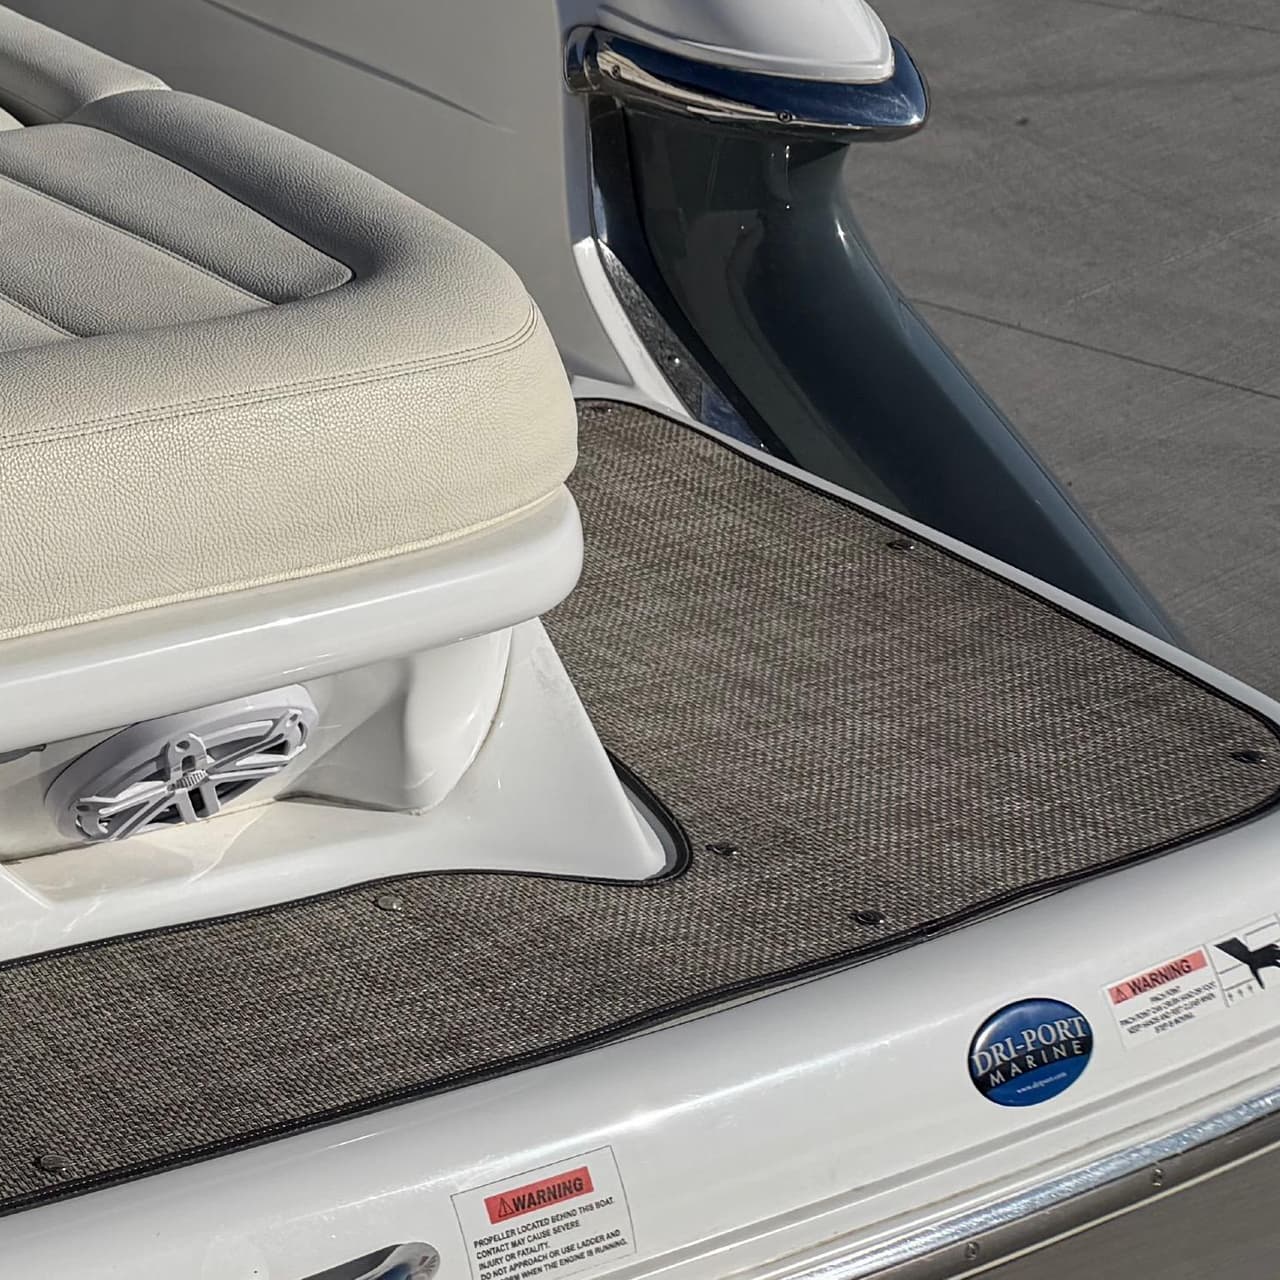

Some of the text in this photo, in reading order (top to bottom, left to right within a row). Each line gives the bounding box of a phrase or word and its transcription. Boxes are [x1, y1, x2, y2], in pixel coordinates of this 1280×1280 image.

[1127, 959, 1192, 995] WARNING
[972, 1016, 1087, 1077] DRI-PORT
[989, 1040, 1083, 1087] MARINE
[512, 1177, 584, 1212] WARNING
[473, 1229, 517, 1248] PROPELLER
[517, 1218, 550, 1234] LOCATED
[551, 1209, 577, 1223] BEHIND
[578, 1203, 594, 1214] THIS
[476, 1242, 510, 1260] CONTACT
[511, 1236, 526, 1248] MAY
[526, 1228, 551, 1243] CAUSE
[479, 1256, 504, 1270] INJURY
[505, 1252, 516, 1262] OR
[480, 1271, 491, 1280] DO
[493, 1266, 508, 1277] NOT
[509, 1253, 548, 1272] APPROACH
[549, 1249, 560, 1258] OR
[561, 1244, 576, 1254] USE
[576, 1234, 605, 1249] LADDER
[606, 1229, 621, 1240] AND
[521, 1266, 543, 1278] WHEN
[543, 1261, 558, 1271] THE
[559, 1251, 585, 1266] ENGINE
